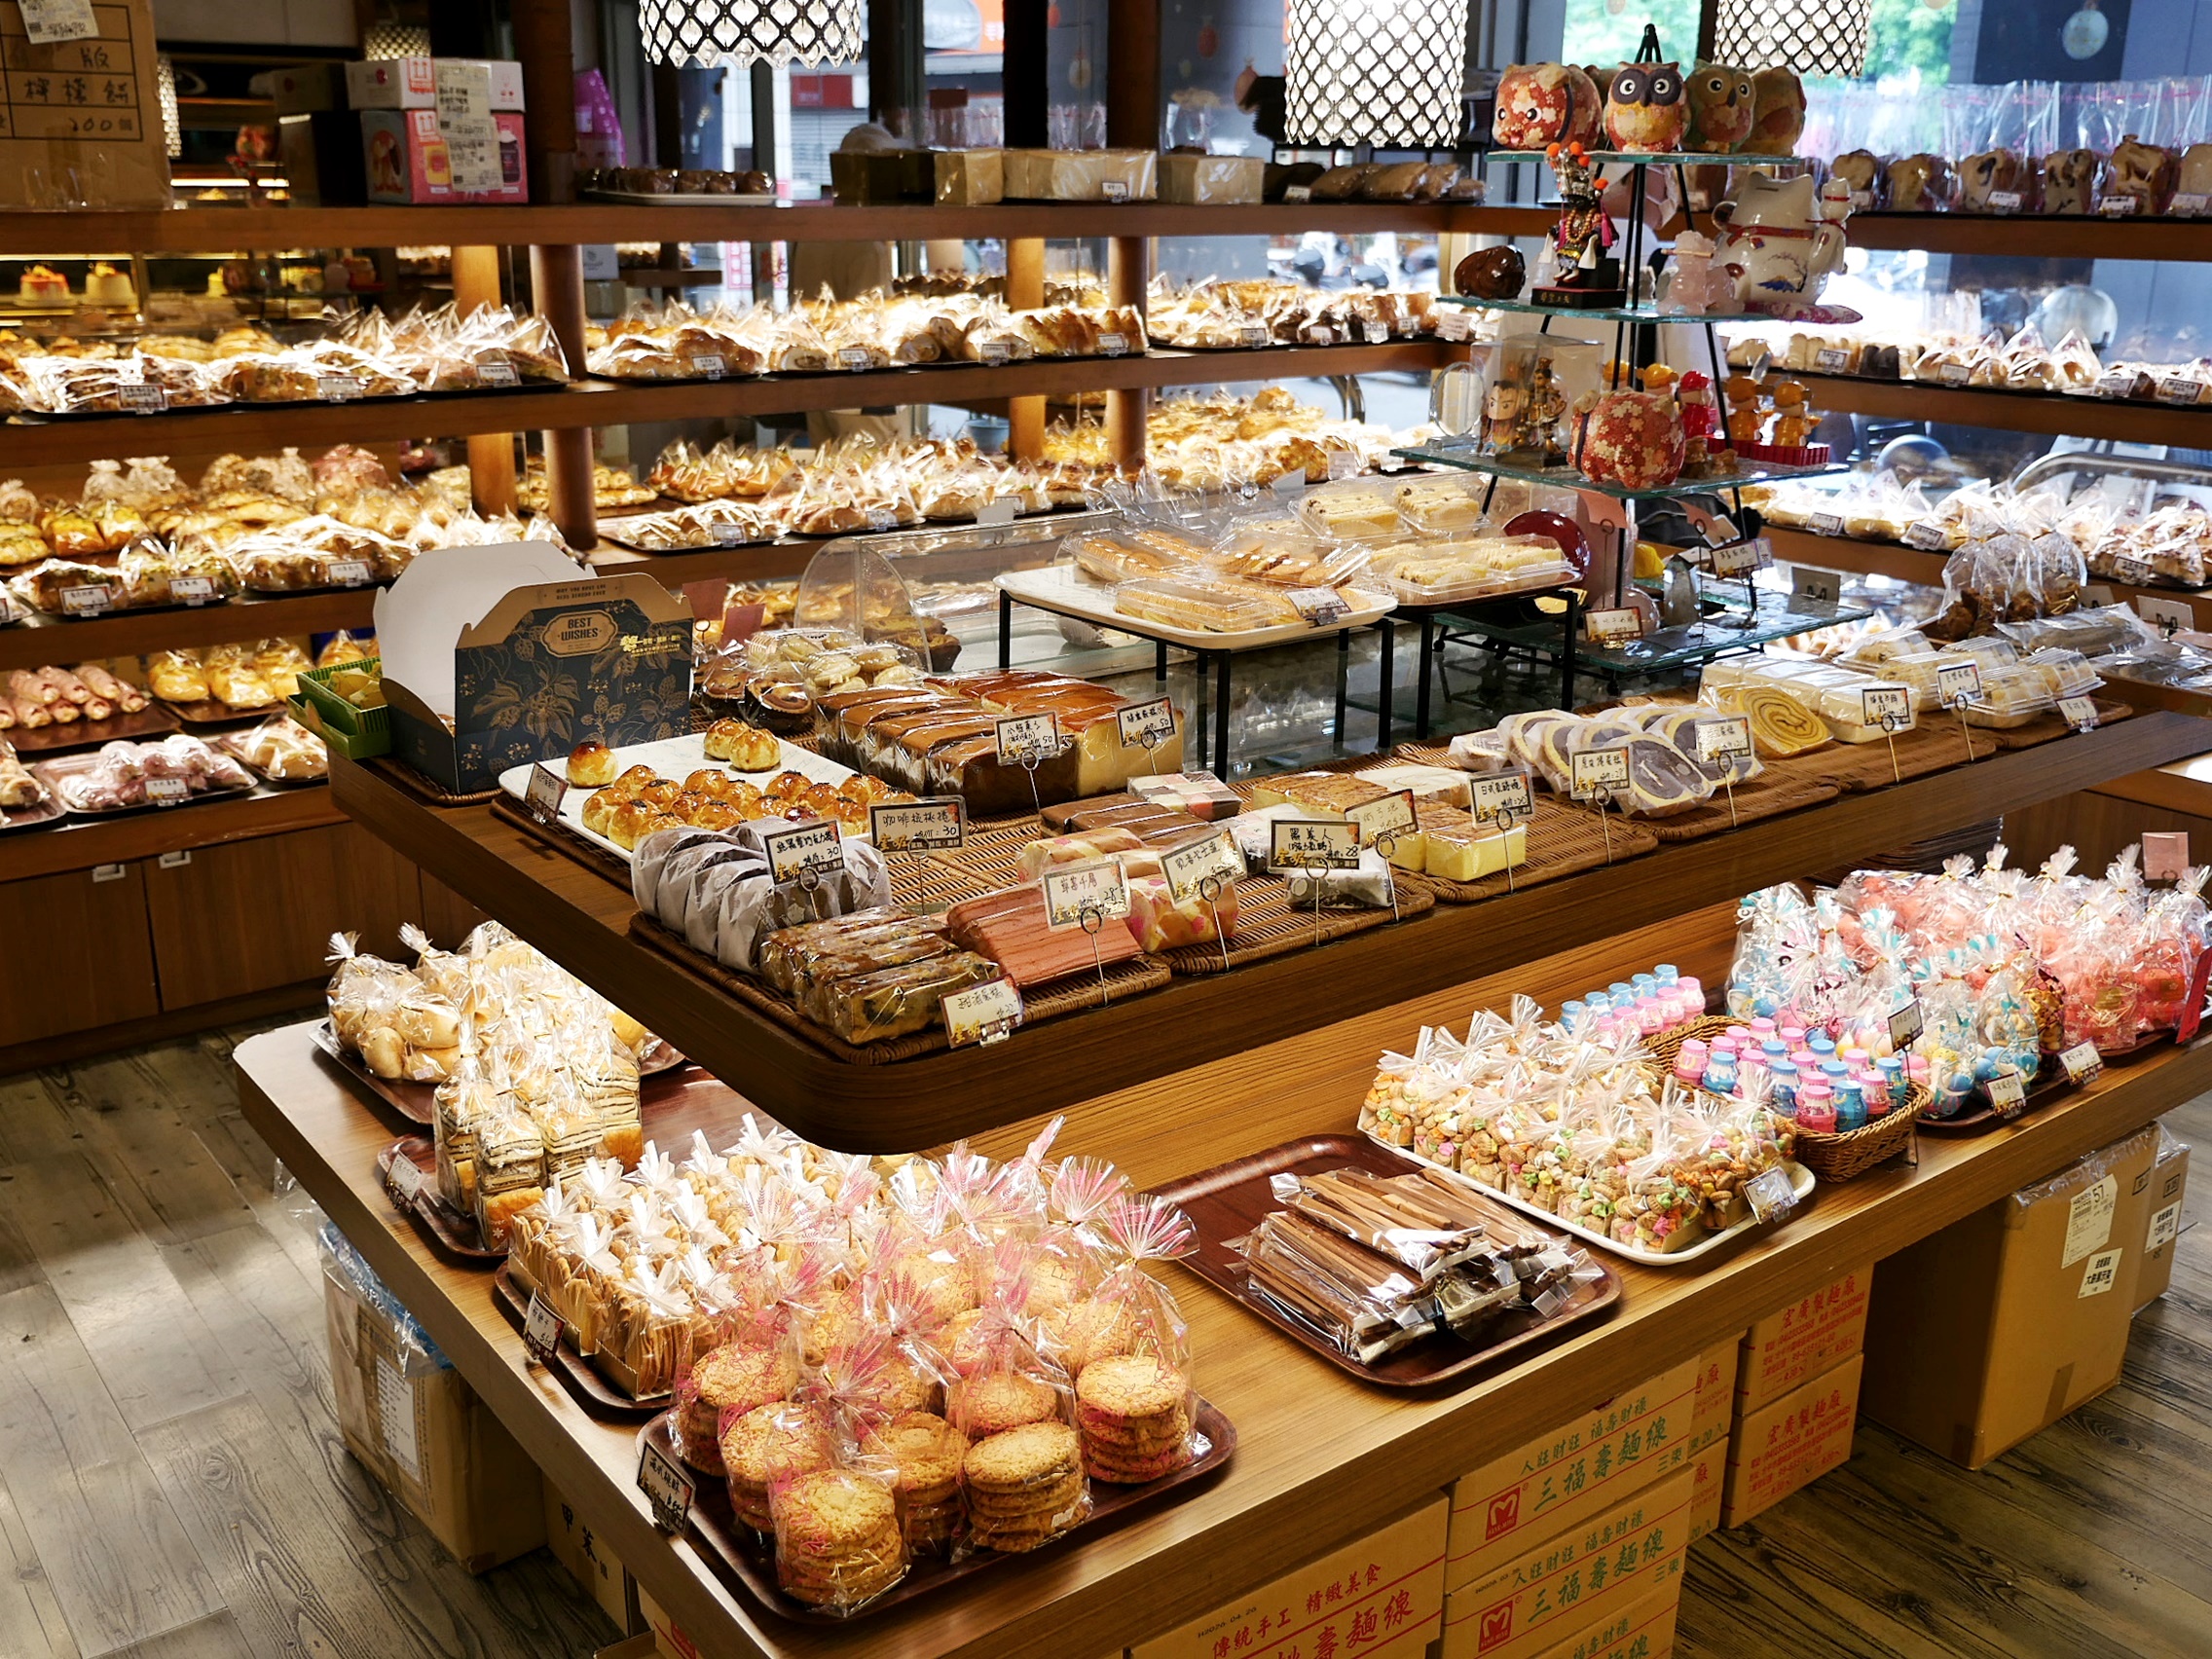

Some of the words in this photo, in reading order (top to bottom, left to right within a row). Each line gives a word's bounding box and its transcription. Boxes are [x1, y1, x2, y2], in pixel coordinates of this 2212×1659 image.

[568, 617, 593, 630] BEST
[561, 628, 599, 642] WISHES
[1160, 718, 1169, 727] 50
[1042, 735, 1052, 744] 50
[942, 825, 958, 836] 30
[827, 846, 839, 858] 30
[1346, 845, 1359, 857] 28
[1533, 1416, 1668, 1512] 三福壽麵線
[1528, 1527, 1666, 1623] 三福壽麵線
[1212, 1608, 1292, 1659] 傳統手工
[1305, 1563, 1382, 1615] 精緻美食
